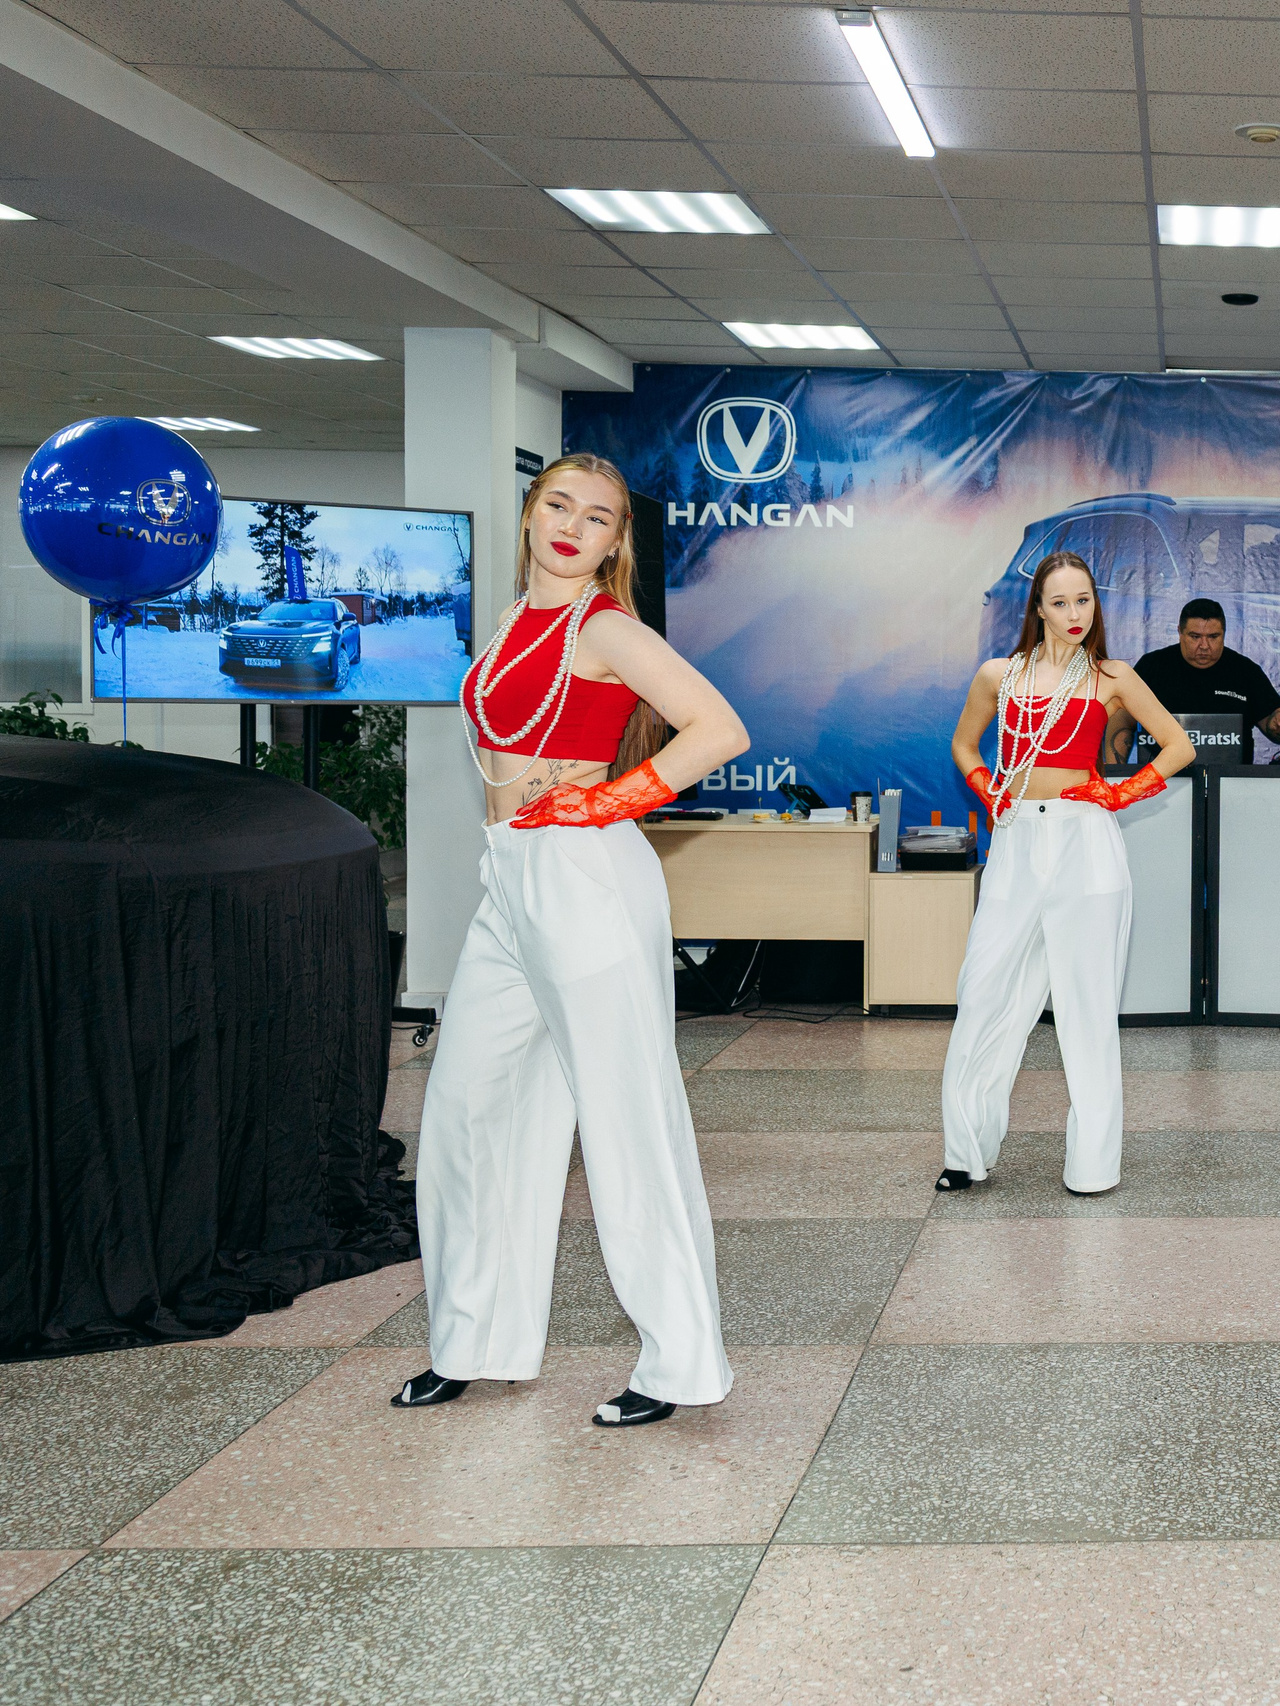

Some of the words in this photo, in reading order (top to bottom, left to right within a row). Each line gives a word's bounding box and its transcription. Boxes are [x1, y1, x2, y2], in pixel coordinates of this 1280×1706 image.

[667, 502, 854, 528] HANGAN
[97, 522, 212, 546] CHANGAN
[415, 524, 460, 533] CHANGAN
[291, 556, 301, 593] CHANGAN
[1138, 730, 1241, 746] soBratsk
[702, 757, 796, 792] ВЫЙ
